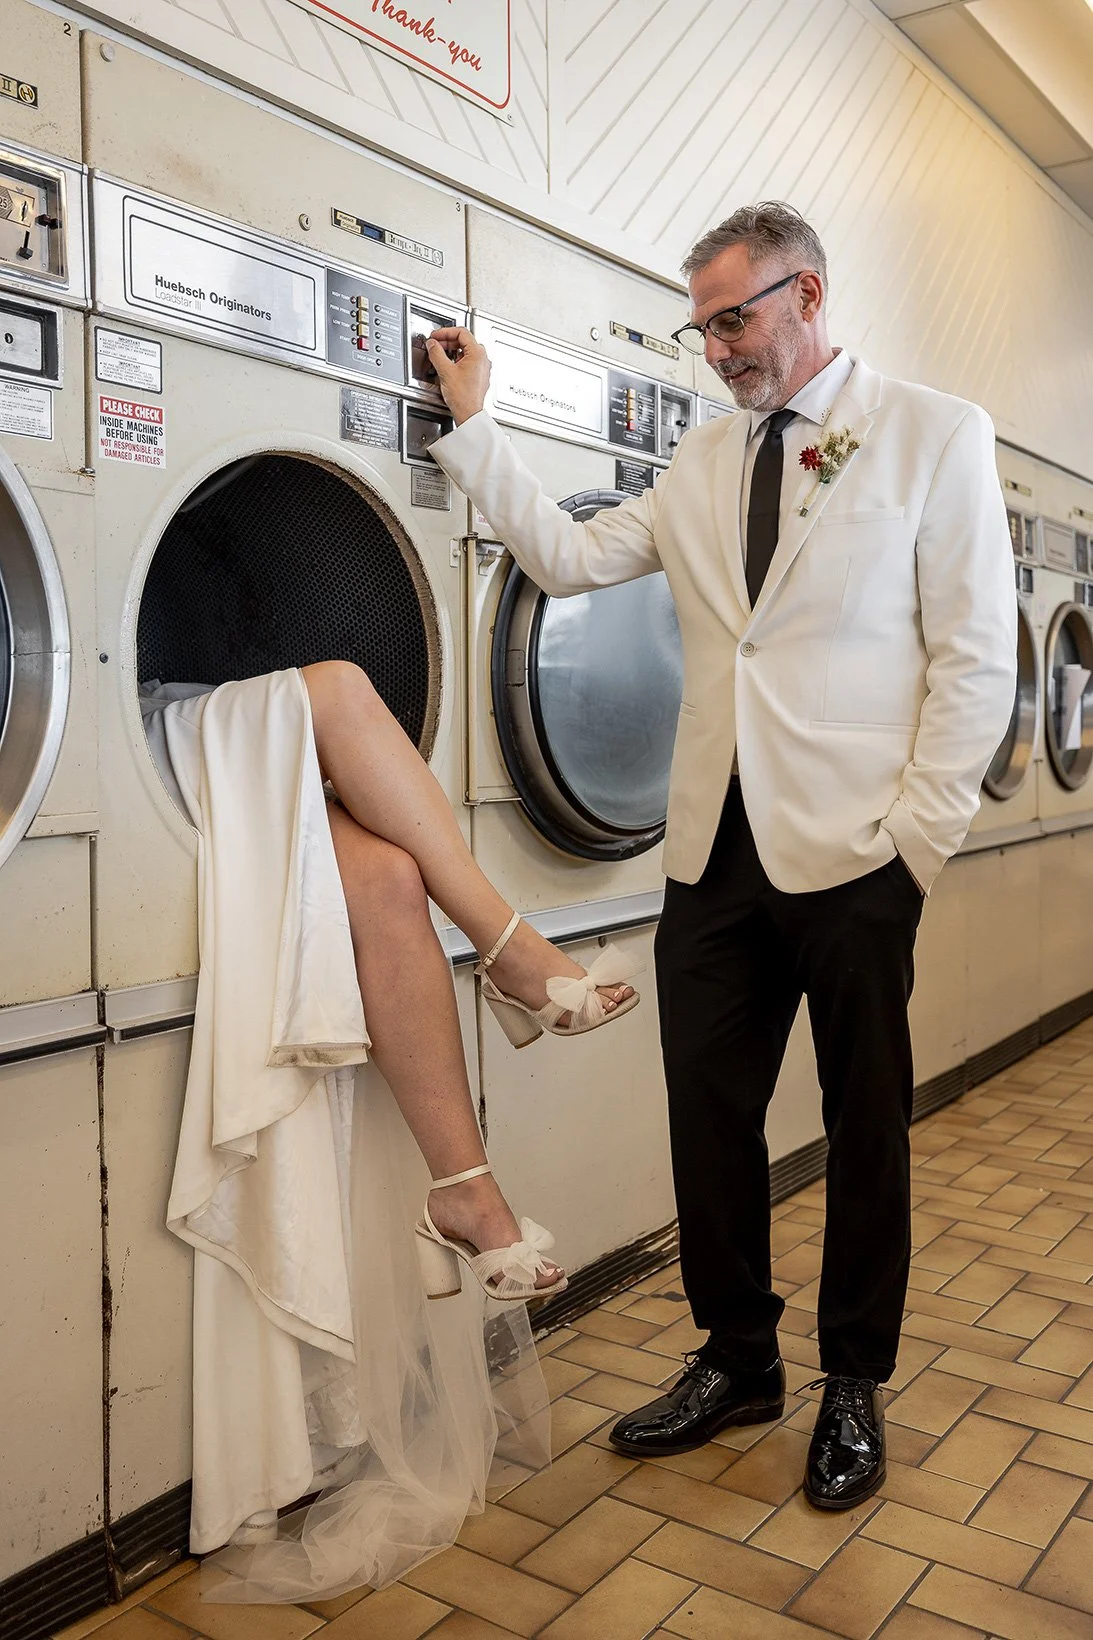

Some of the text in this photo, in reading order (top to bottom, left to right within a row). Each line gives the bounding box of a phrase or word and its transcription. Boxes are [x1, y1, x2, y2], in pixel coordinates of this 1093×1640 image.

[63, 22, 71, 37] 2
[455, 201, 461, 212] 3
[155, 274, 272, 321] Huebsch Originators
[155, 287, 192, 308] Loadstar
[509, 384, 576, 413] Huebsch Originators
[102, 398, 161, 422] PLEASE CHECK
[99, 415, 164, 437] INSIDE MACHINES
[105, 427, 158, 446] BEFORE USING
[100, 438, 164, 457] NOT RESPONSIBLE FOR
[104, 448, 161, 466] DAMAGED ARTICLES
